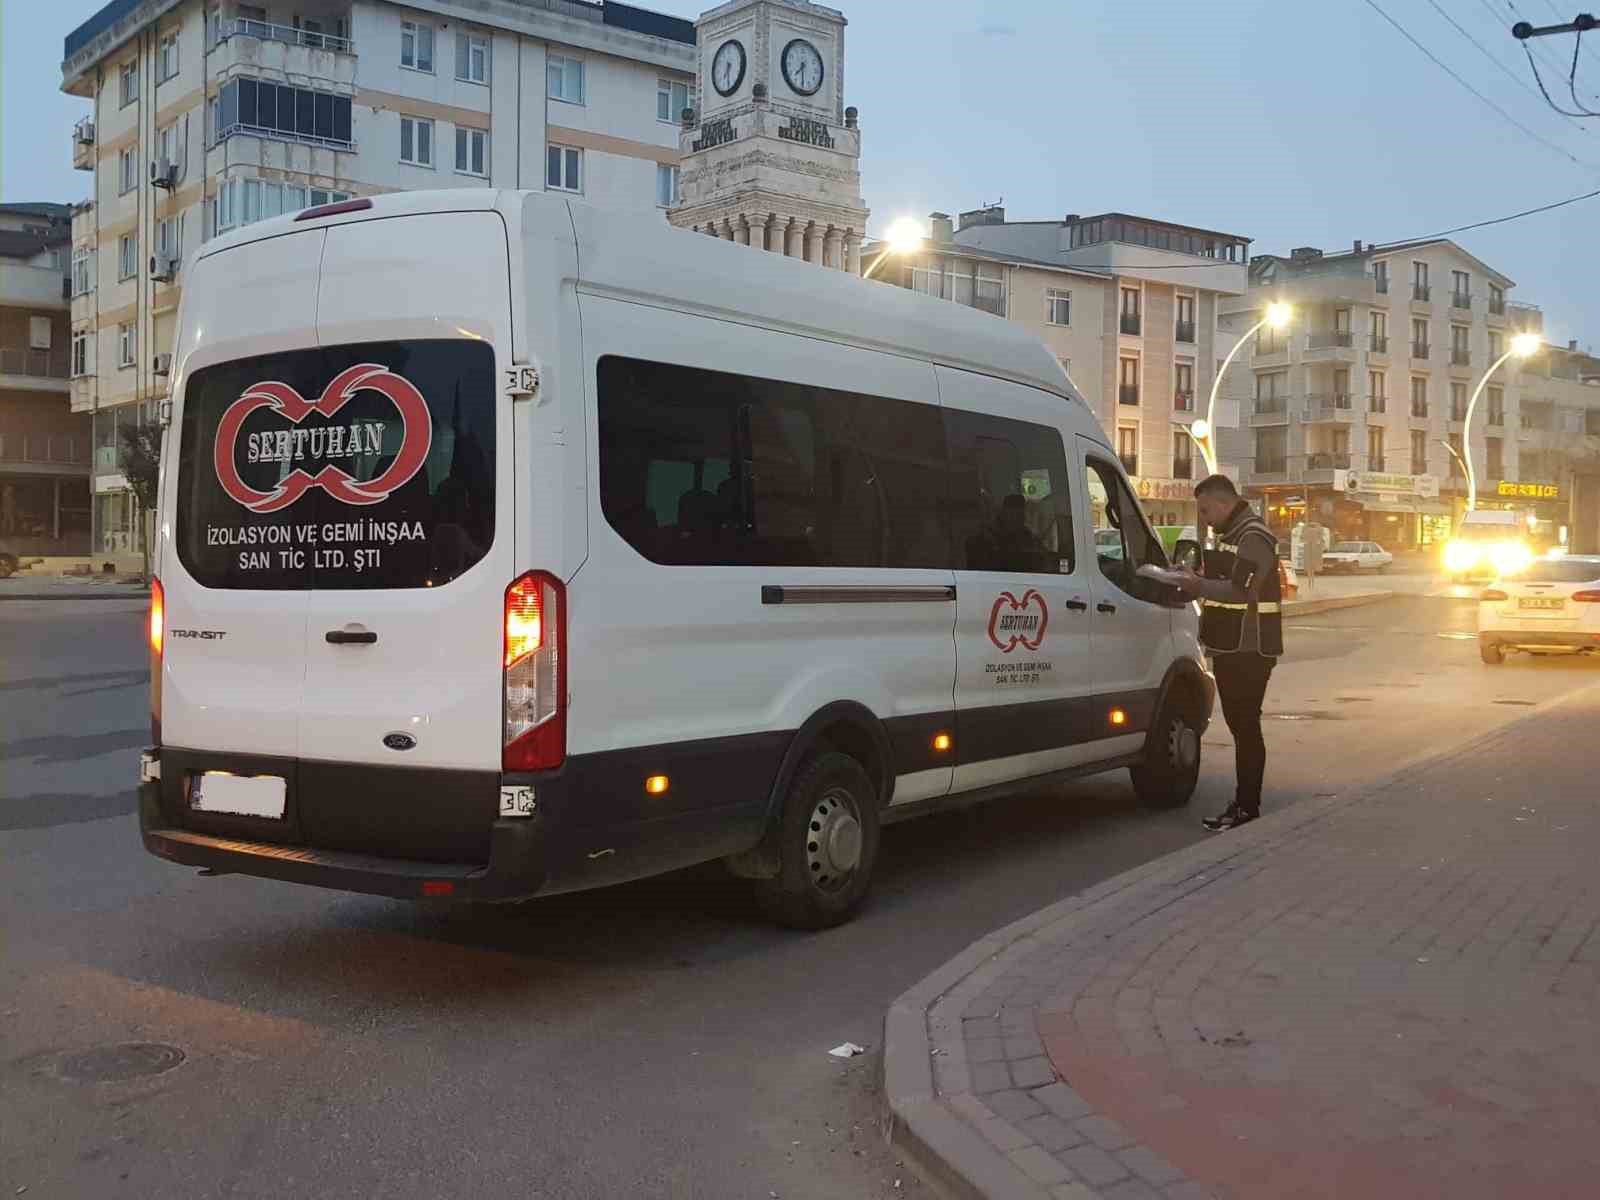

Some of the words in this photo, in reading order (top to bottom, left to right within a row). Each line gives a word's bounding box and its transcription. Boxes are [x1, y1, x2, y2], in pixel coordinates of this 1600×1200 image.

[247, 421, 386, 463] SERTUHAN
[207, 523, 291, 546] İZOLASYON
[296, 524, 318, 544] VE
[322, 518, 364, 543] GEMİ
[239, 551, 270, 570] SAN
[314, 550, 349, 569] LTD.
[171, 629, 226, 640] TRANSIT
